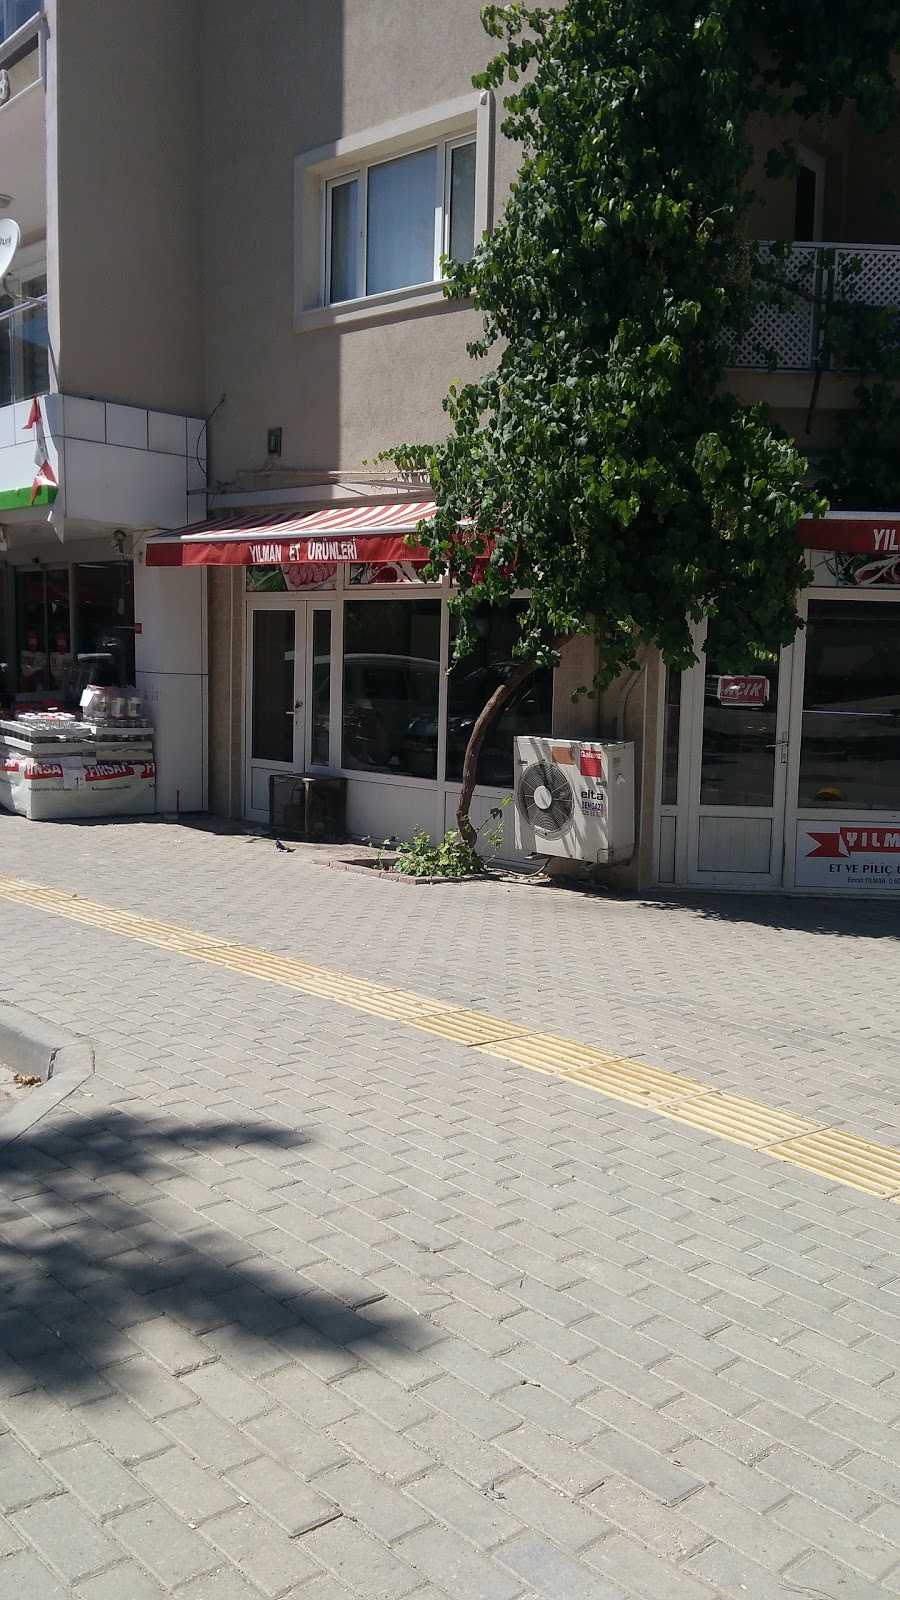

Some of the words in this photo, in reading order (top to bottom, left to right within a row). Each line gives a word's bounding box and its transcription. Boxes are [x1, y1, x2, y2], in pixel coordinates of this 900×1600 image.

[873, 529, 899, 551] YIL
[249, 544, 282, 562] YILMAN
[289, 543, 301, 560] ET
[307, 537, 358, 560] ÜRÜNLERİ
[87, 763, 127, 777] FIRSAT
[581, 790, 604, 801] elta
[829, 863, 842, 873] ET
[846, 864, 858, 873] VE
[863, 863, 892, 876] PİLİÇ
